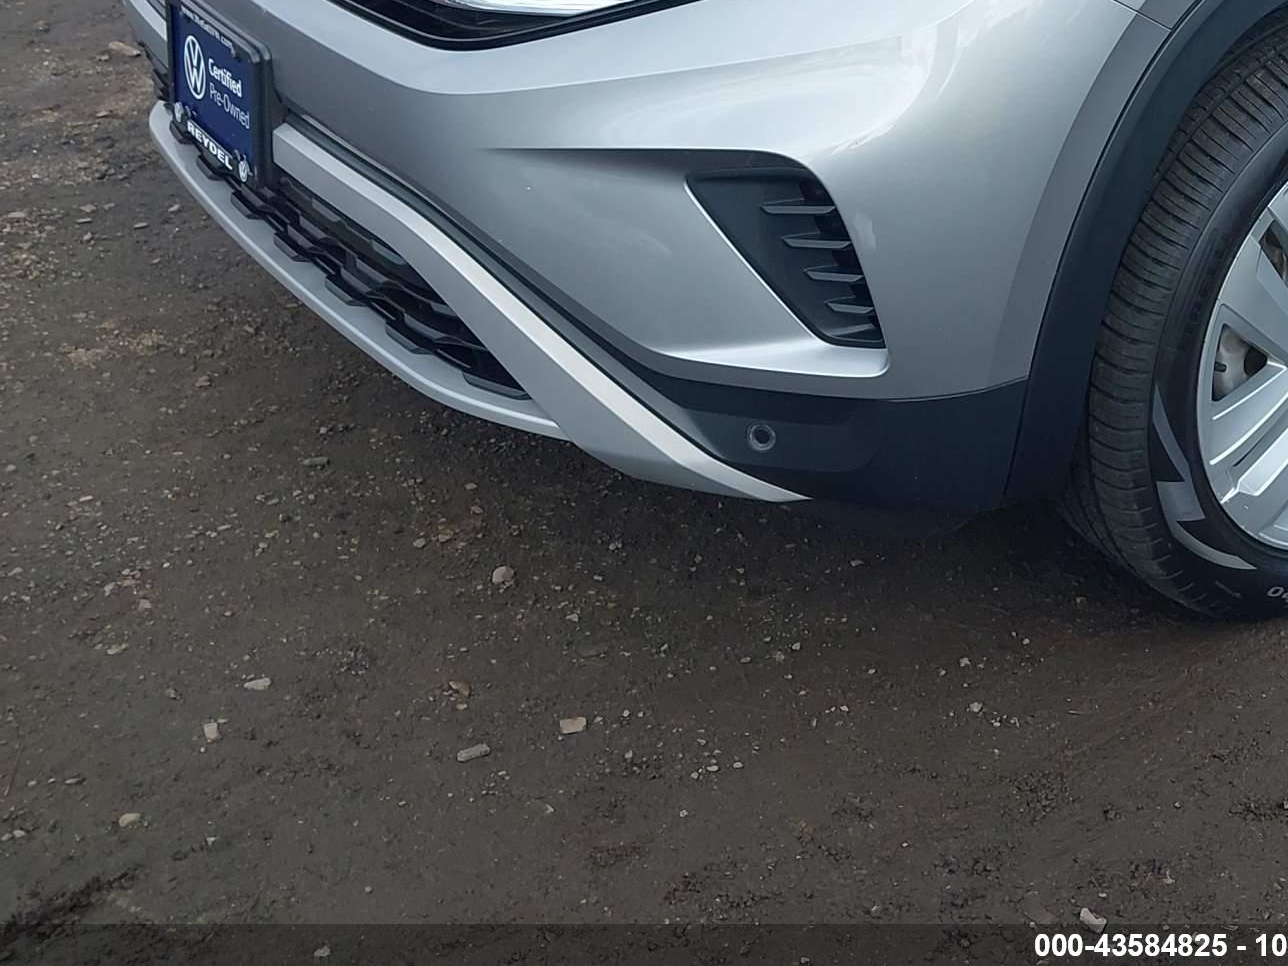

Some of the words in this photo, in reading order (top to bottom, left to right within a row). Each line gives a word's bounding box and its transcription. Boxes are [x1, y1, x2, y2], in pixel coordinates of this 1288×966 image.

[208, 58, 242, 98] Certified
[209, 82, 250, 129] Pre-Owned
[187, 121, 233, 171] REYDEL
